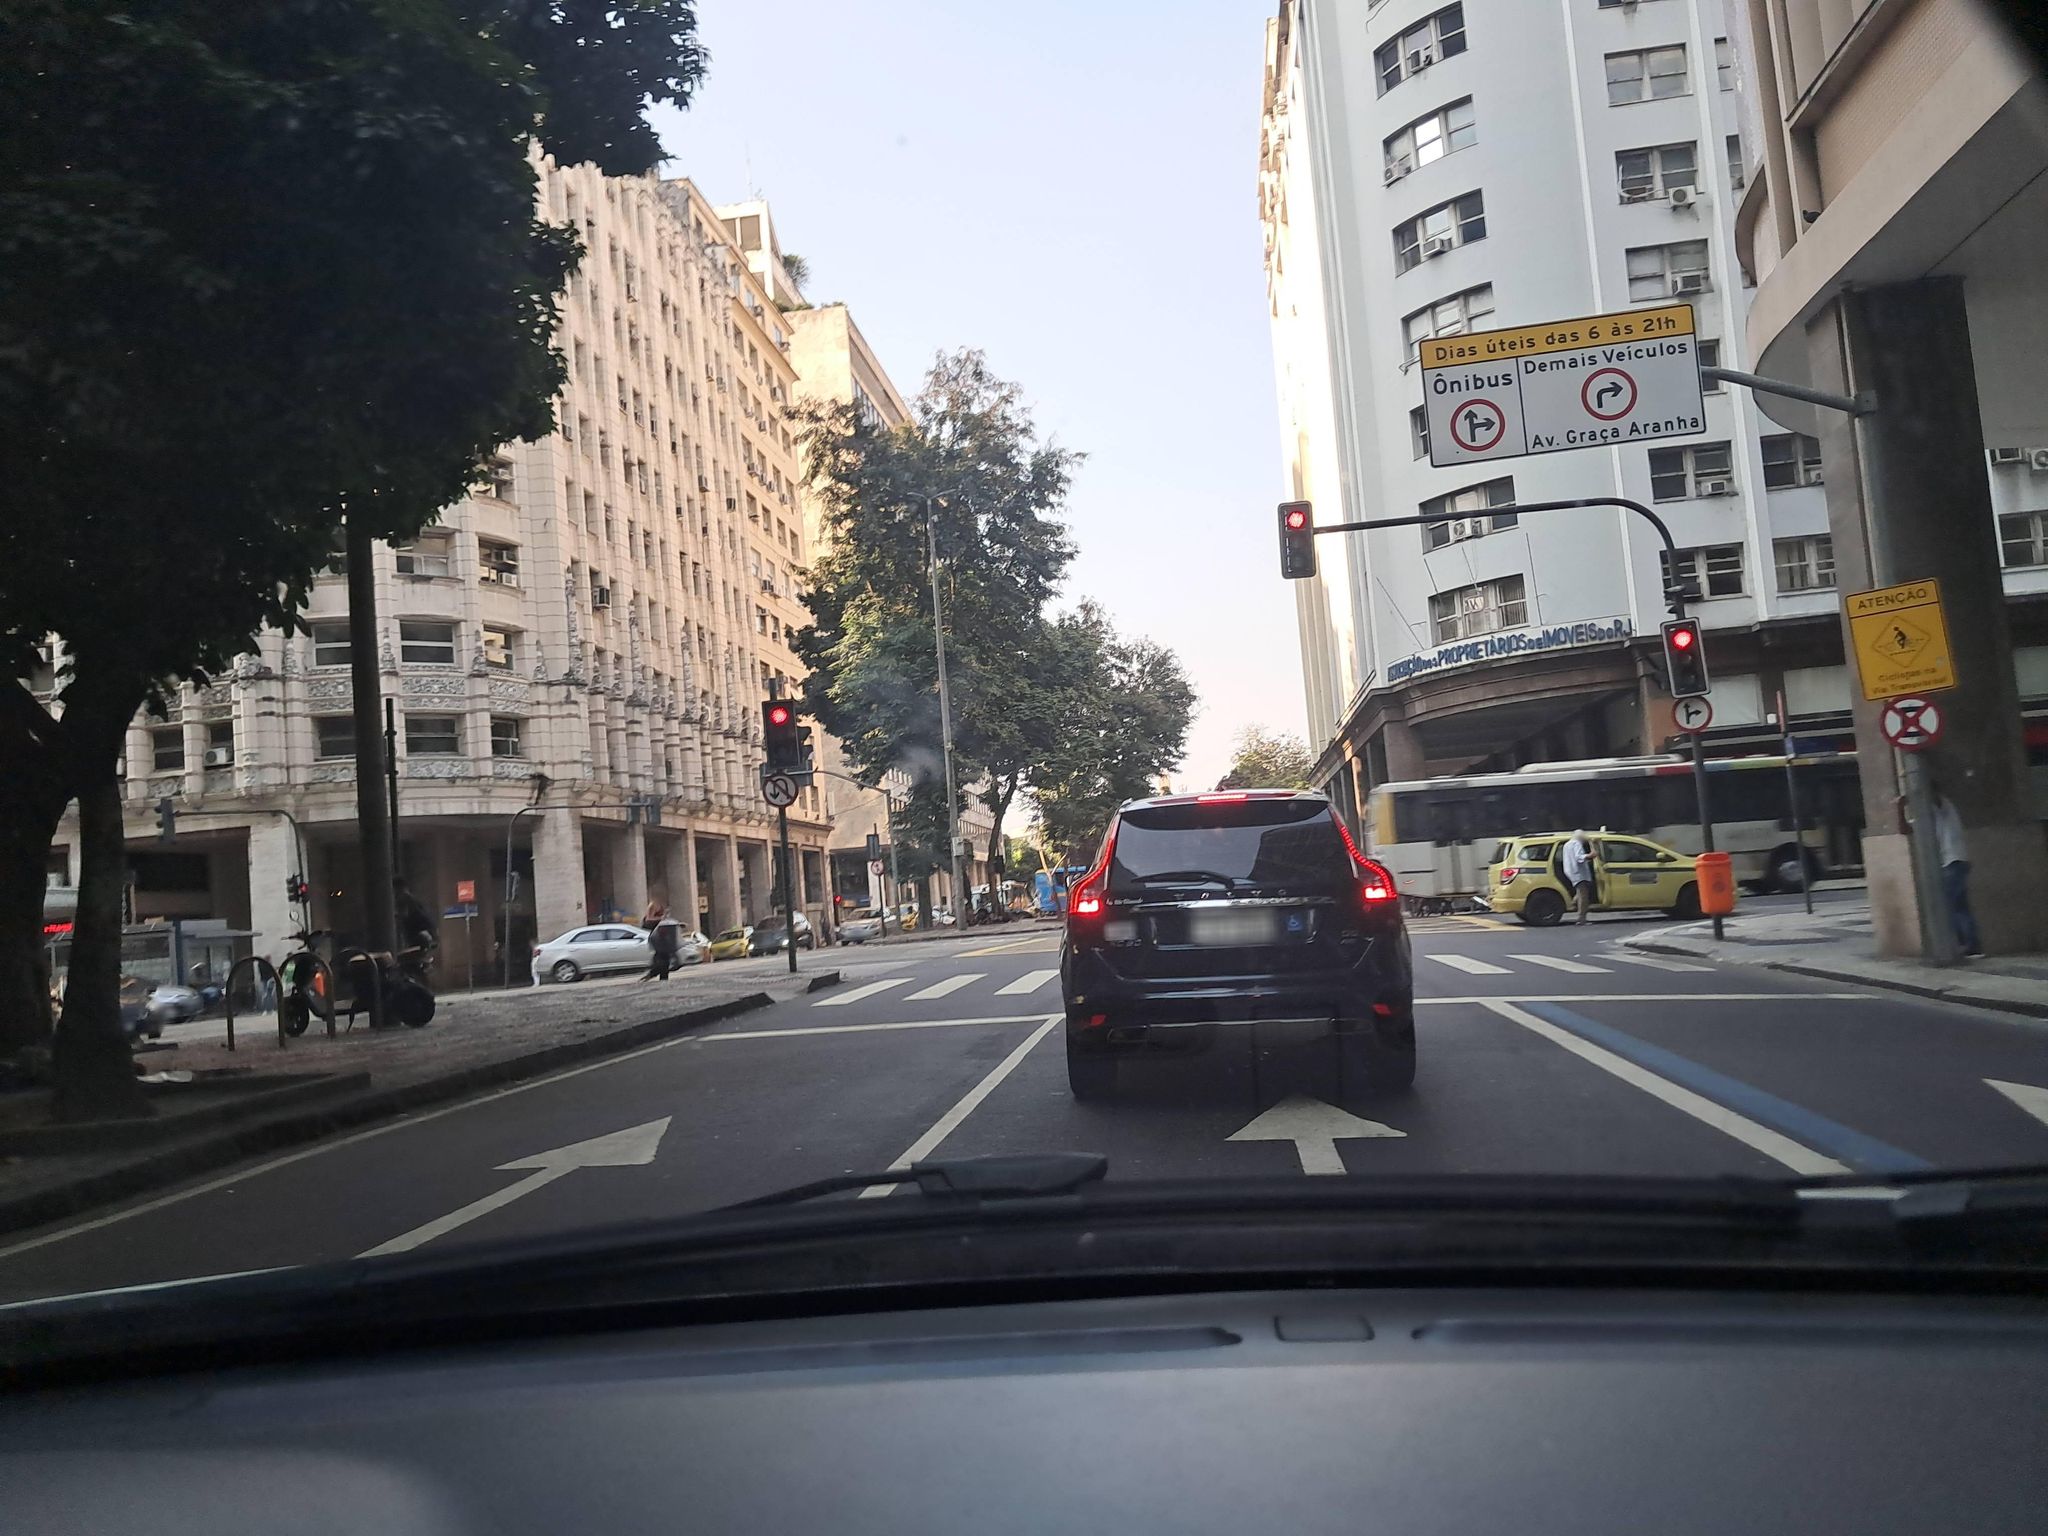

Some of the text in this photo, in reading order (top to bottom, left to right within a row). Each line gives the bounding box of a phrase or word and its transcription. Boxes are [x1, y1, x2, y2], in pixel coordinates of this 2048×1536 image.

[1435, 317, 1677, 361] Dias úteis das 6 às 21h
[1524, 341, 1688, 375] Demais Veículos
[1433, 372, 1514, 396] Ônibus
[1532, 415, 1700, 449] Av. Graça Aranha
[1857, 588, 1927, 610] ATENÇÃO
[1613, 618, 1633, 639] RJ
